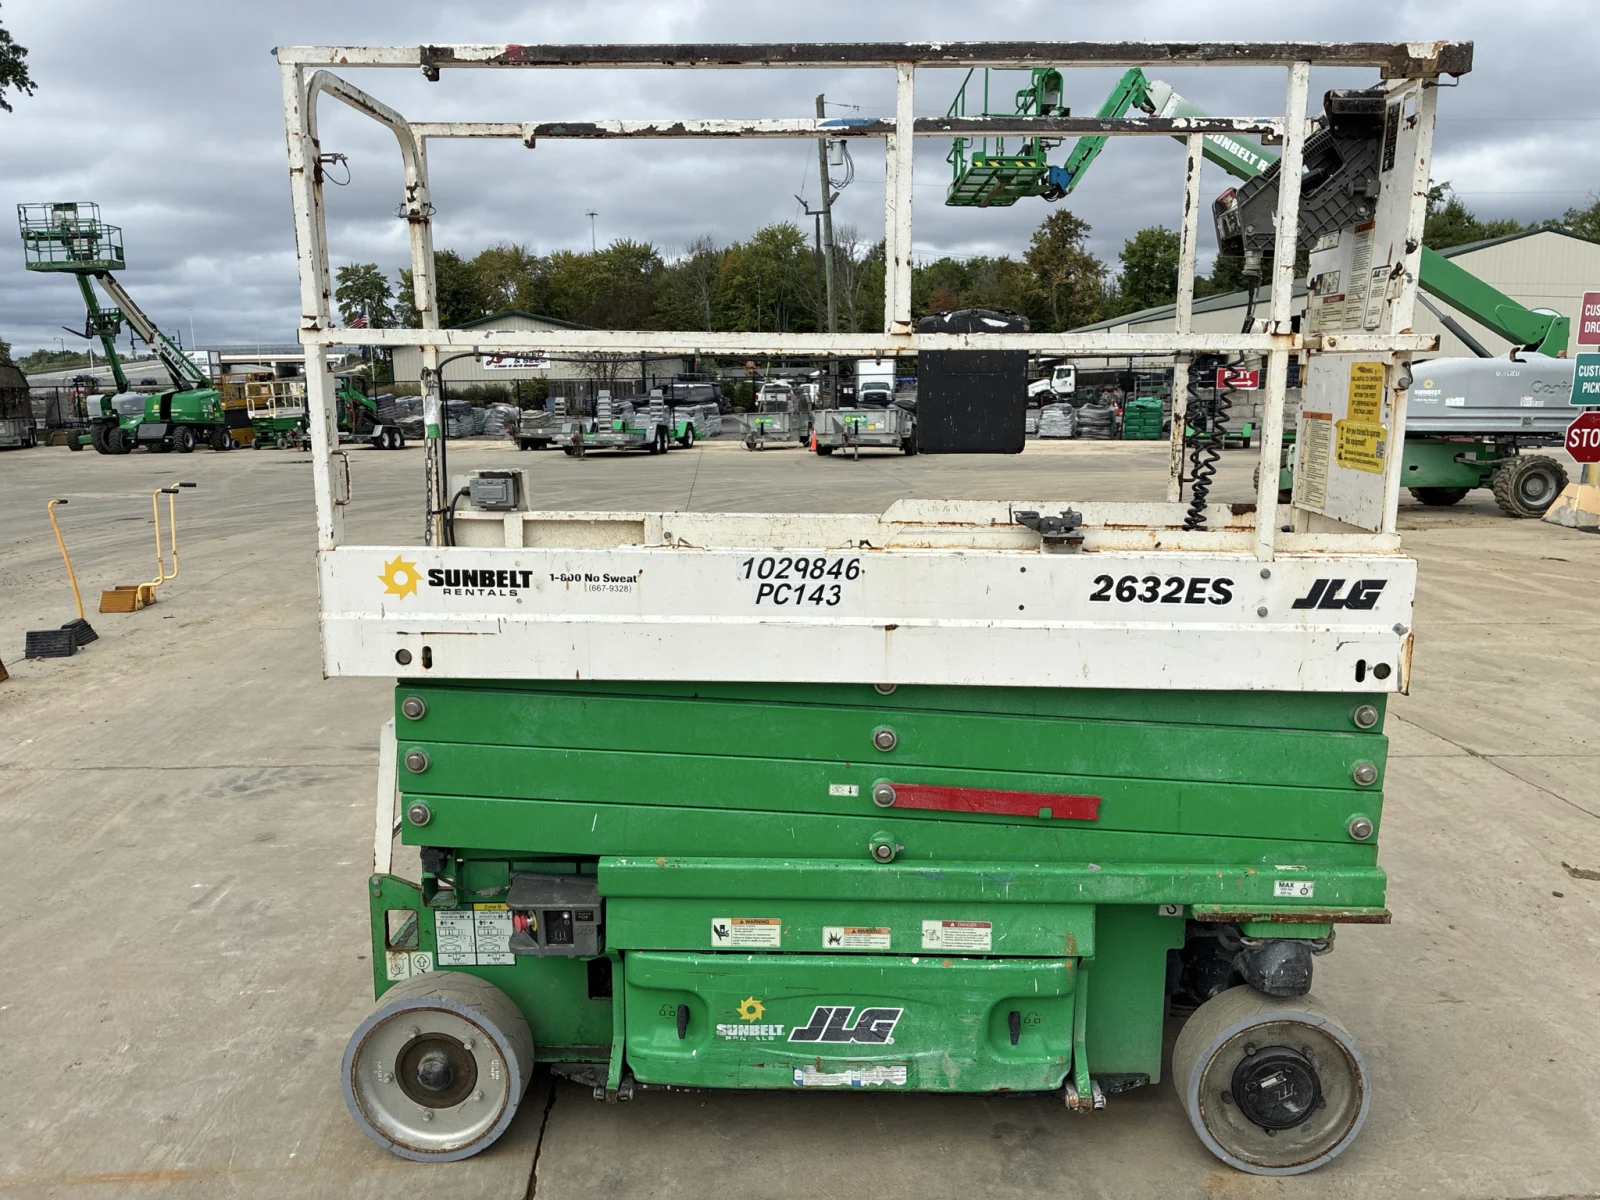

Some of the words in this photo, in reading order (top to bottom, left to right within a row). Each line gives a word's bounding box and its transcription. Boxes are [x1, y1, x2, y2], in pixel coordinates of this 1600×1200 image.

[1224, 370, 1252, 379] EIT
[1578, 365, 1600, 377] CUST
[742, 557, 860, 580] 1029846
[428, 569, 533, 588] SUNBELT
[549, 573, 581, 582] 1-800
[584, 573, 600, 582] No
[602, 573, 638, 583] Sweat
[443, 588, 518, 596] RENTALS
[588, 584, 632, 593] (667-9328)
[755, 583, 842, 606] PC143
[1089, 574, 1235, 605] 2632ES
[1290, 579, 1388, 610] JLG
[716, 1023, 786, 1036] SUNBELT
[787, 1005, 905, 1044] JLG
